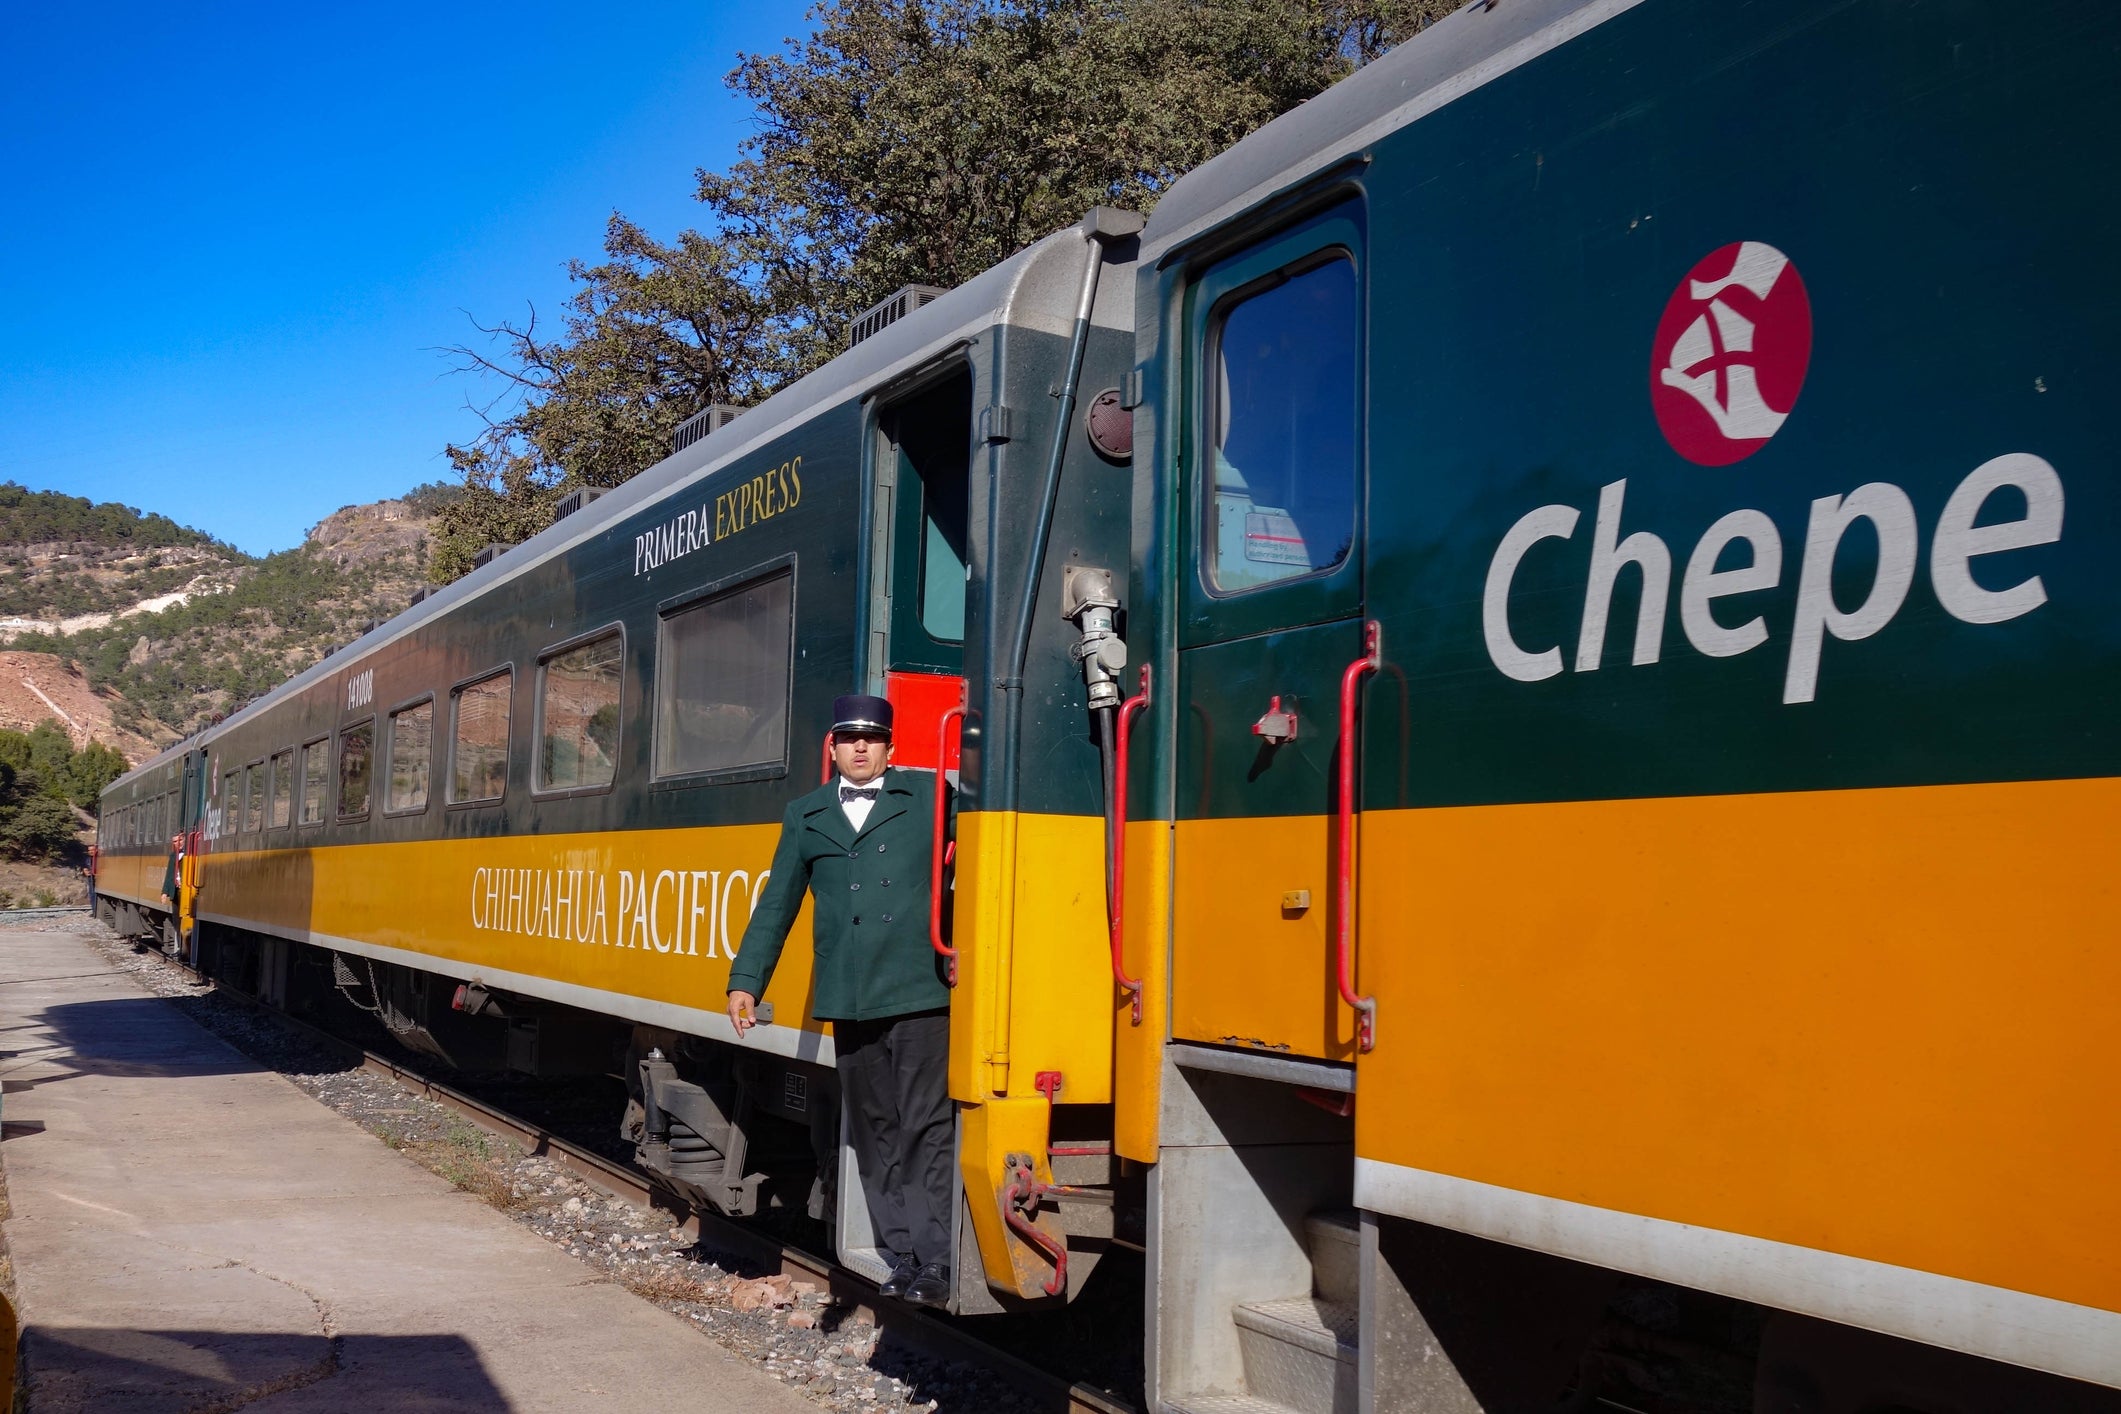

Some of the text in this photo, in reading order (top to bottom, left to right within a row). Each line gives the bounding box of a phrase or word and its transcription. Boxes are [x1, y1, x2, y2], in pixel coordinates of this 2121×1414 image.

[634, 455, 802, 577] PRIMERA EXPRESS
[347, 668, 374, 711] 141008
[471, 867, 609, 946] CHIHUAHUA
